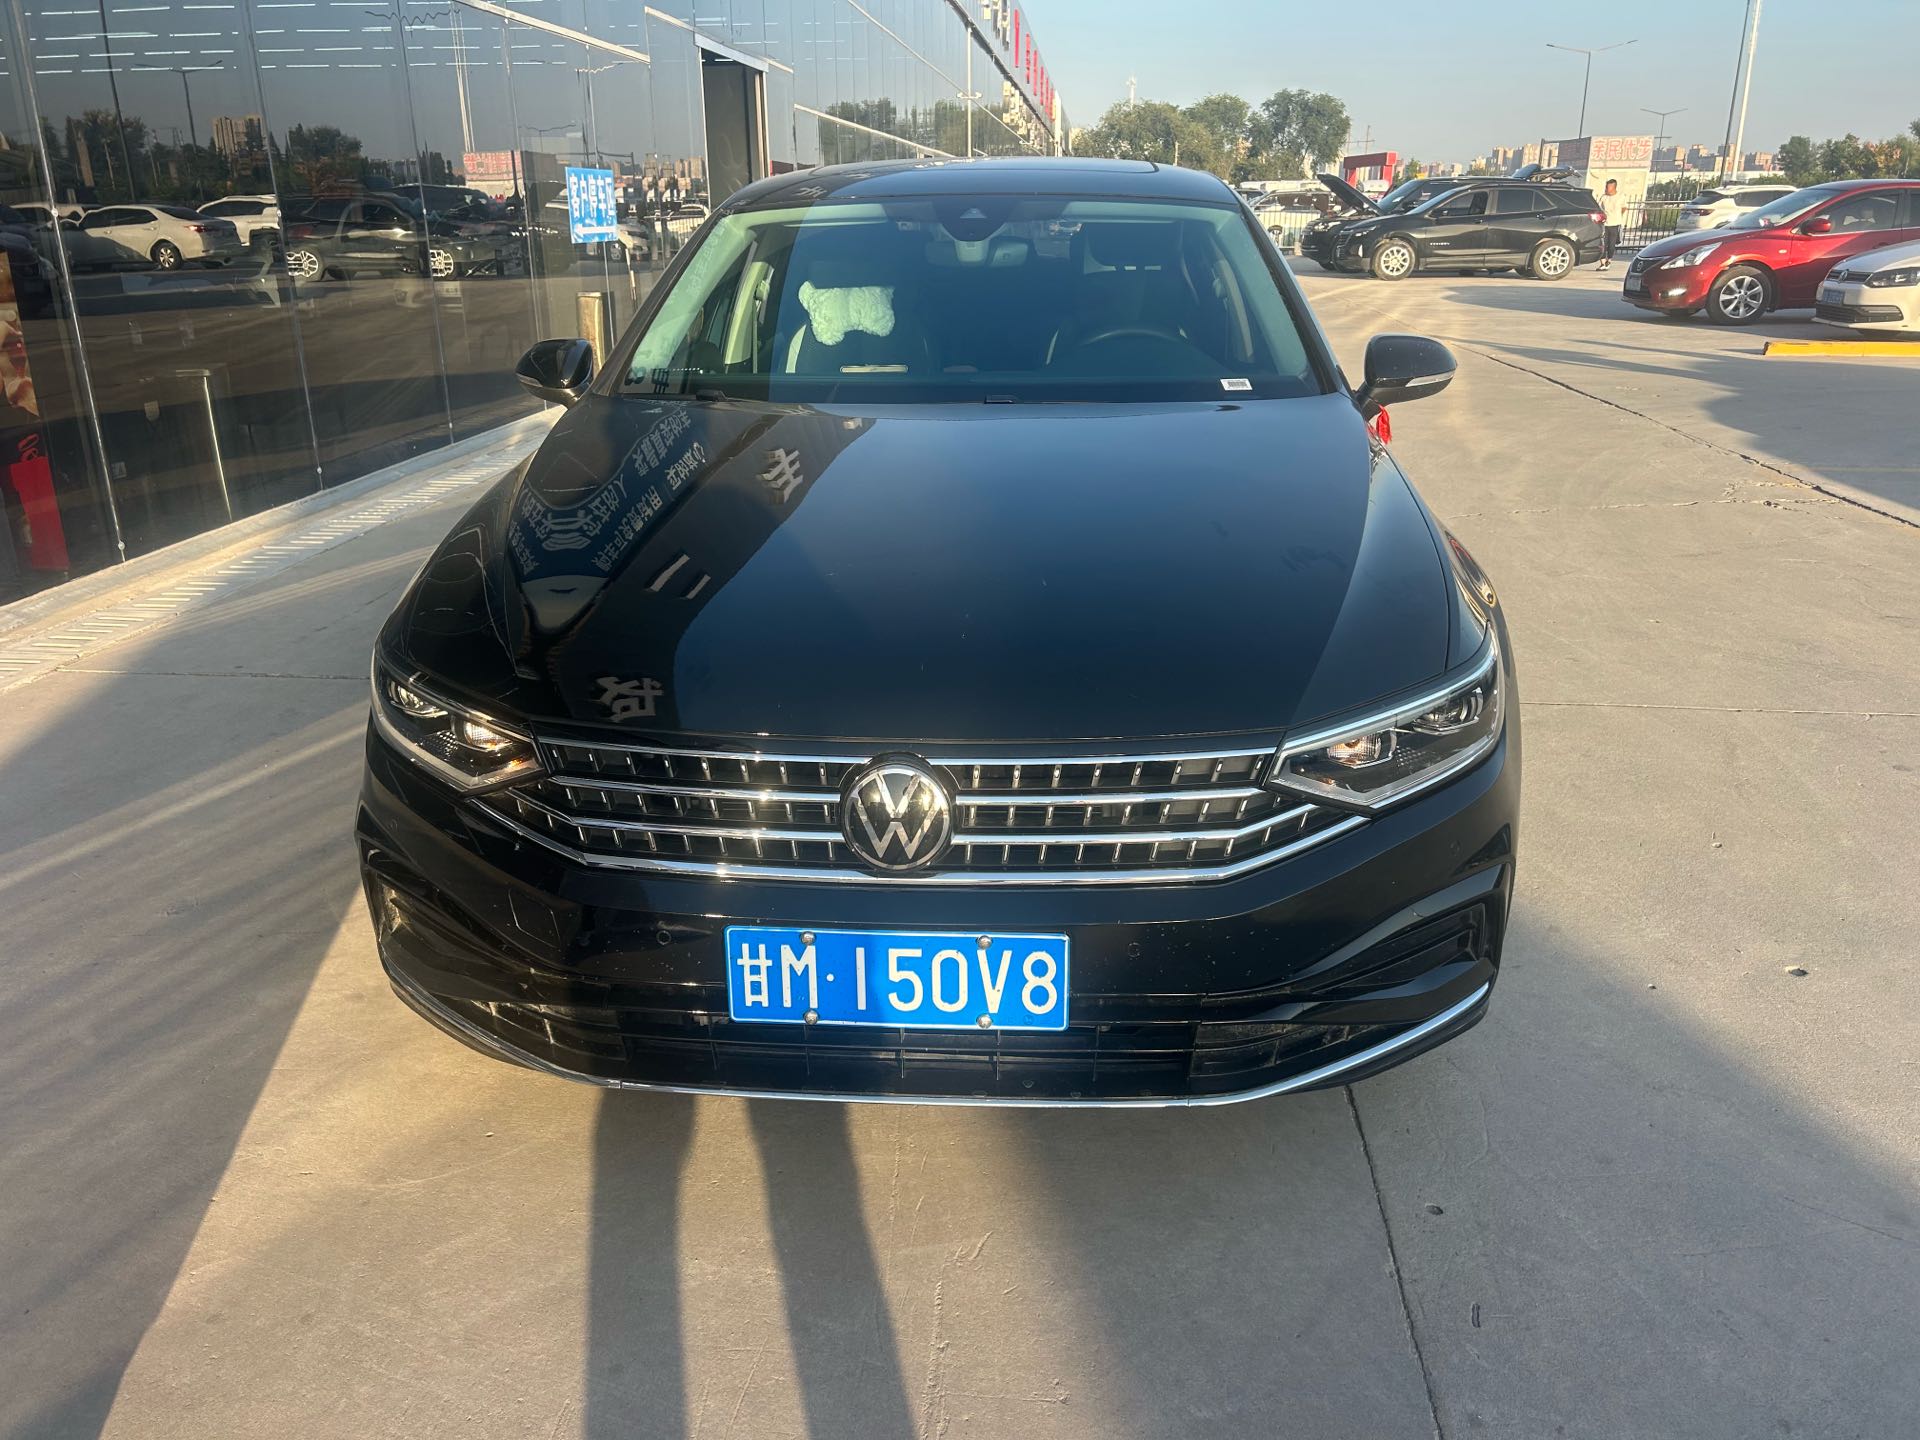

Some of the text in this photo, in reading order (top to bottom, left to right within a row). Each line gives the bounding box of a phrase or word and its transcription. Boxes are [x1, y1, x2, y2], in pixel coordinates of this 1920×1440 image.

[1592, 137, 1653, 160] 亲民代步
[569, 173, 615, 218] 客户停车区
